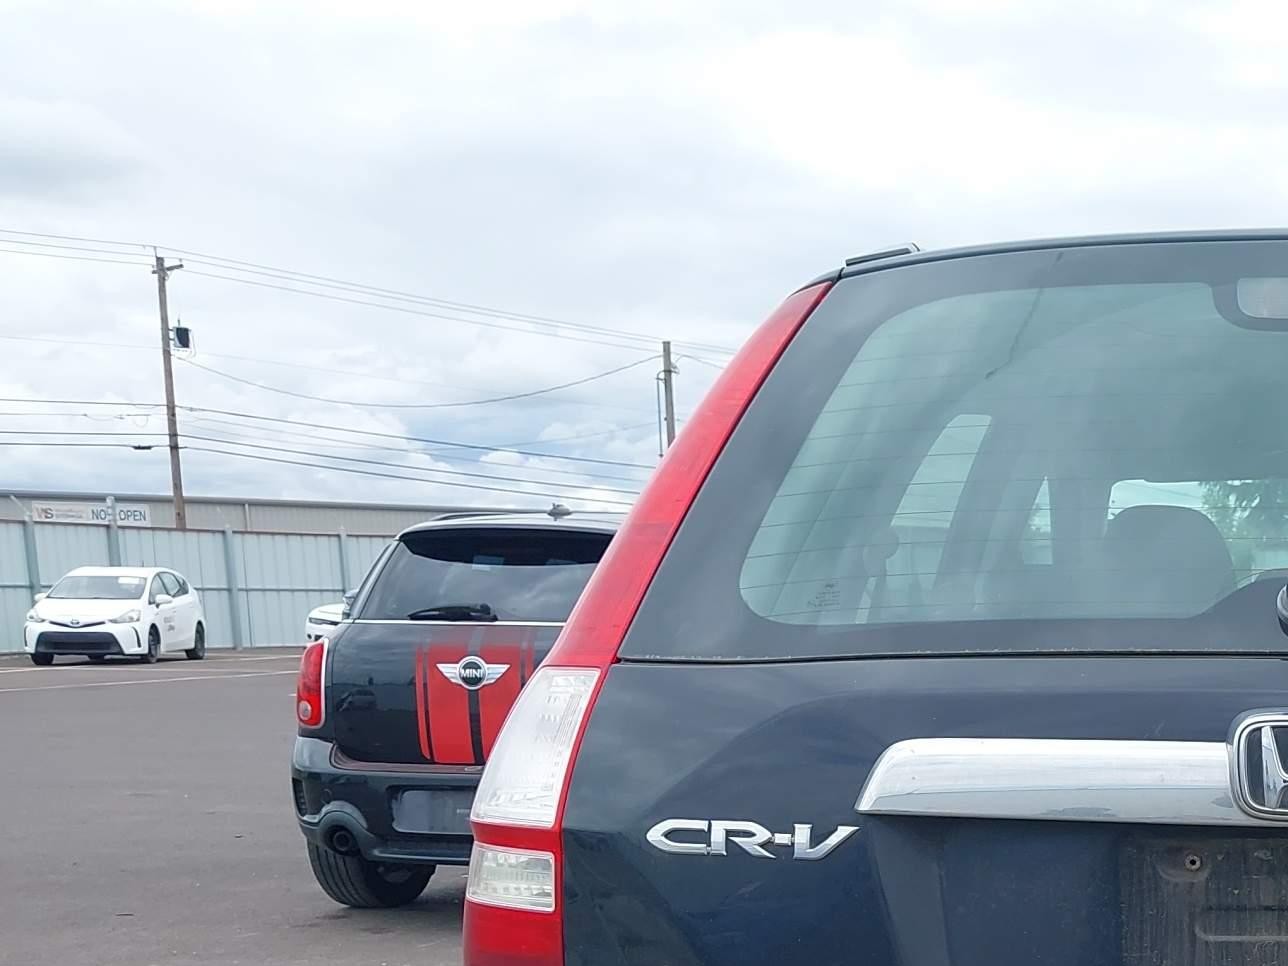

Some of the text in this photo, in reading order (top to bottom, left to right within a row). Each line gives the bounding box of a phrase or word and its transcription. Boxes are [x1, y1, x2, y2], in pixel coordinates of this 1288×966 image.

[118, 509, 147, 522] OPEN
[460, 668, 484, 679] MINI
[646, 818, 860, 861] CR-V
